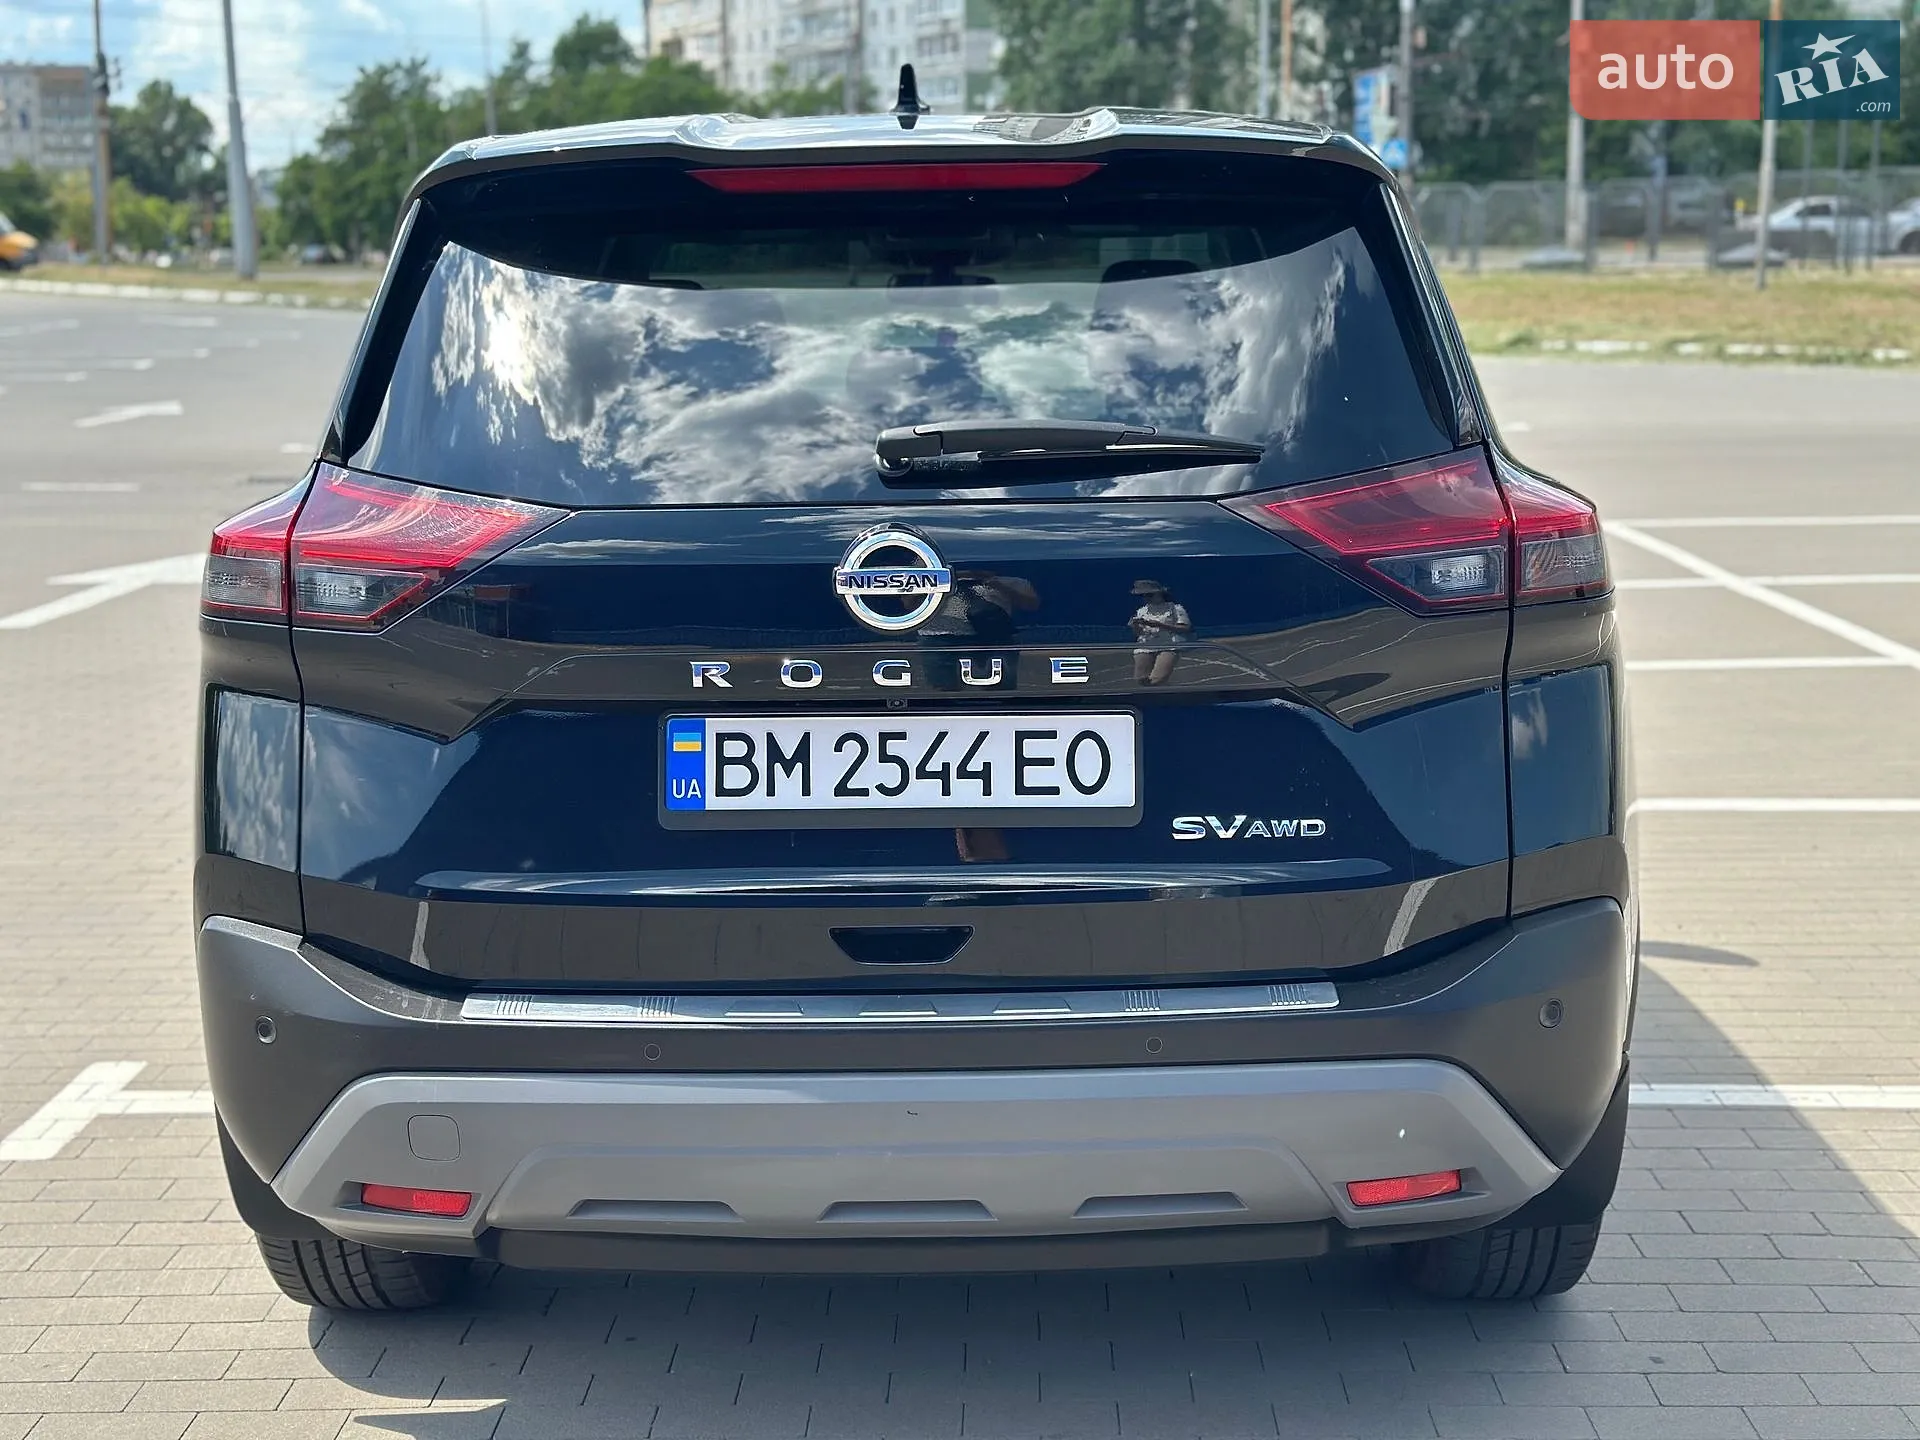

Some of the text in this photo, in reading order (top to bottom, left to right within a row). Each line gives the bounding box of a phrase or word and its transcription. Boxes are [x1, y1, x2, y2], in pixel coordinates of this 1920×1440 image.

[848, 574, 938, 589] NISSAN
[689, 656, 1090, 688] ROGUE
[714, 729, 1111, 798] BM 2544 EO
[672, 779, 702, 799] UA
